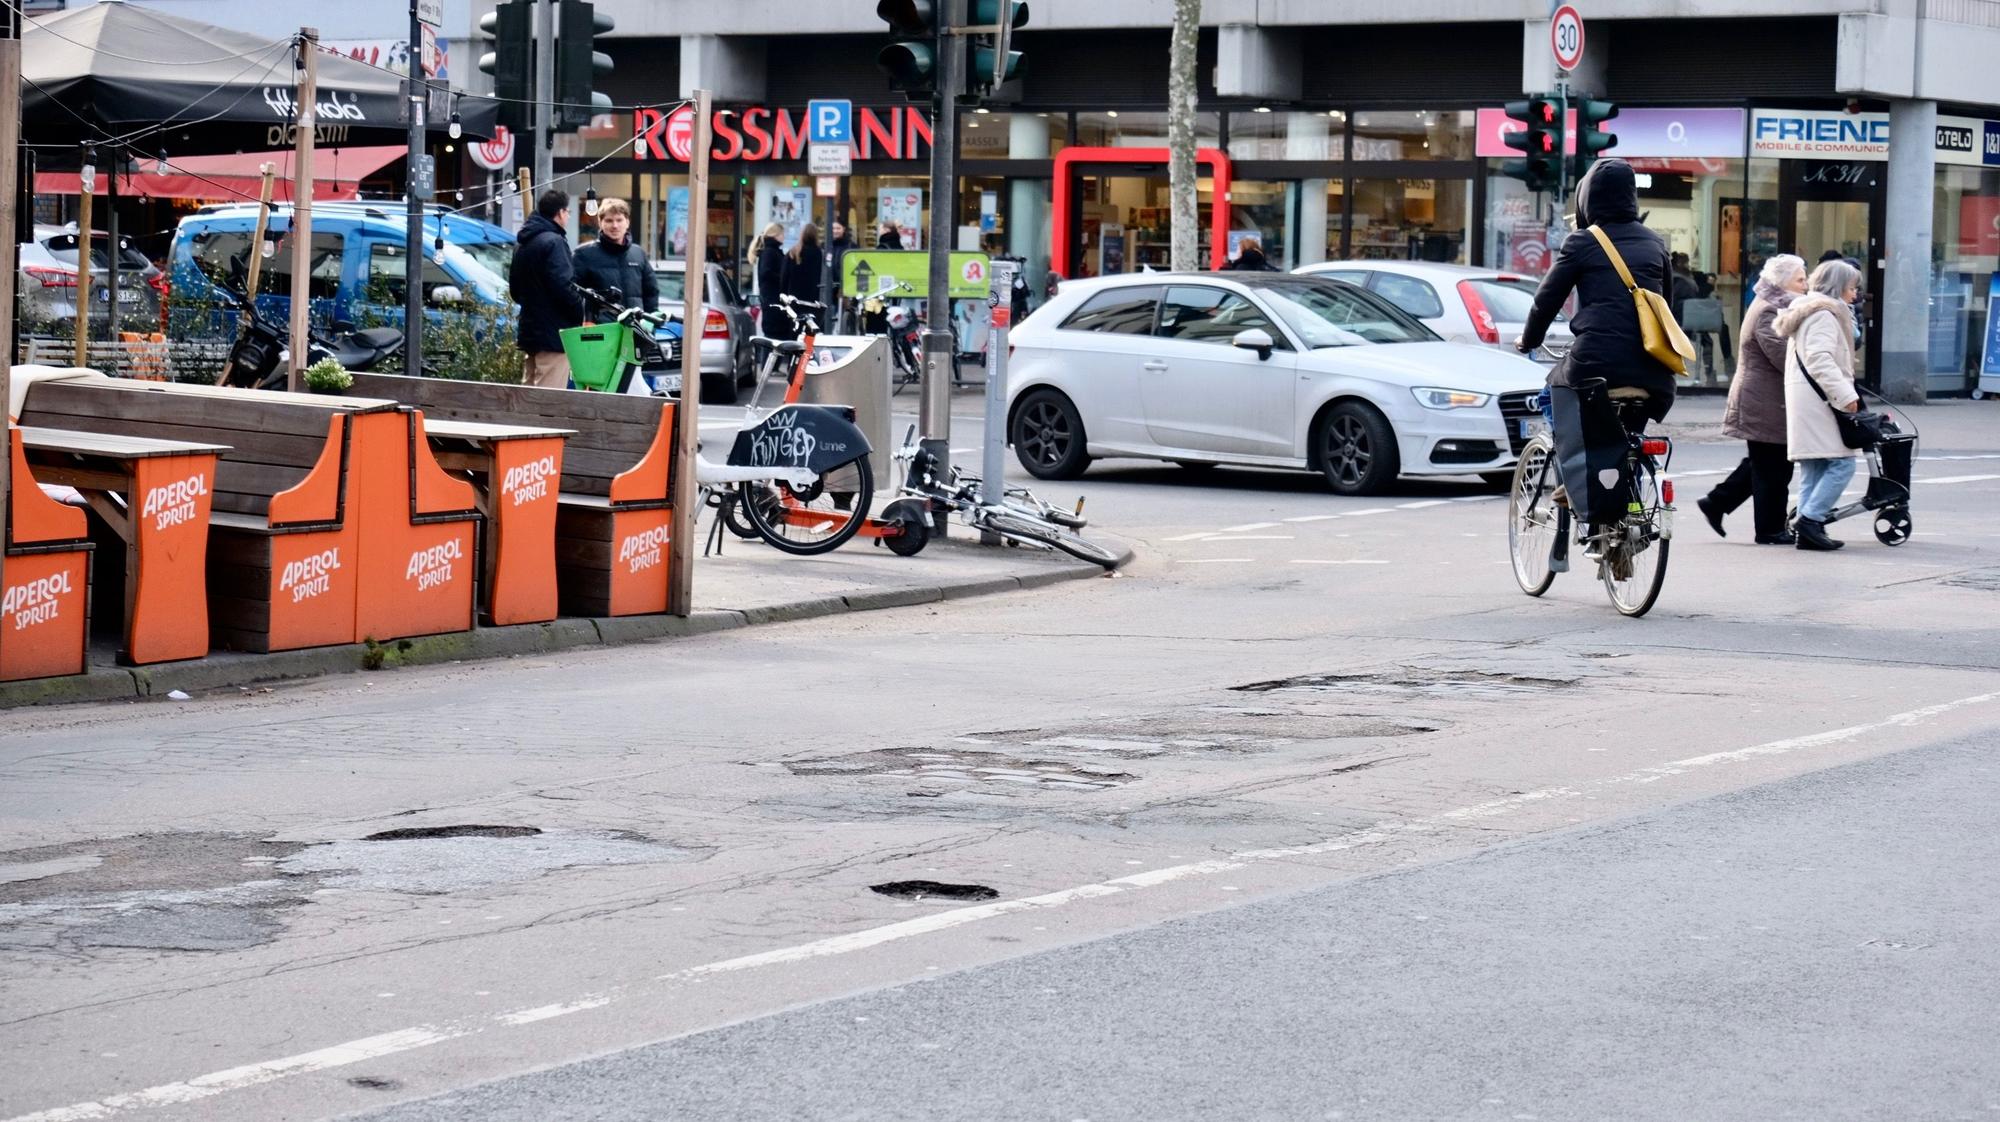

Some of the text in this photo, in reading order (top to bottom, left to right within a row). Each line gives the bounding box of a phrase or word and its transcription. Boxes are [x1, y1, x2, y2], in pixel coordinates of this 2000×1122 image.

[1558, 23, 1577, 52] 30
[818, 106, 841, 138] P
[1755, 142, 1801, 151] MOBILE
[1985, 132, 2000, 154] 1&1
[502, 455, 557, 495] APEROL
[142, 473, 208, 518] APEROL
[514, 480, 547, 507] SPRITZ
[156, 501, 196, 531] SPRITZ
[619, 524, 671, 563] APEROL
[279, 547, 341, 591] APEROL
[405, 538, 462, 580] APEROL
[630, 548, 661, 574] SPRITZ
[293, 574, 330, 603] SPRITZ
[418, 564, 452, 592] SPRITZ
[1, 570, 72, 618] APEROL
[15, 600, 58, 630] SPRITZ
